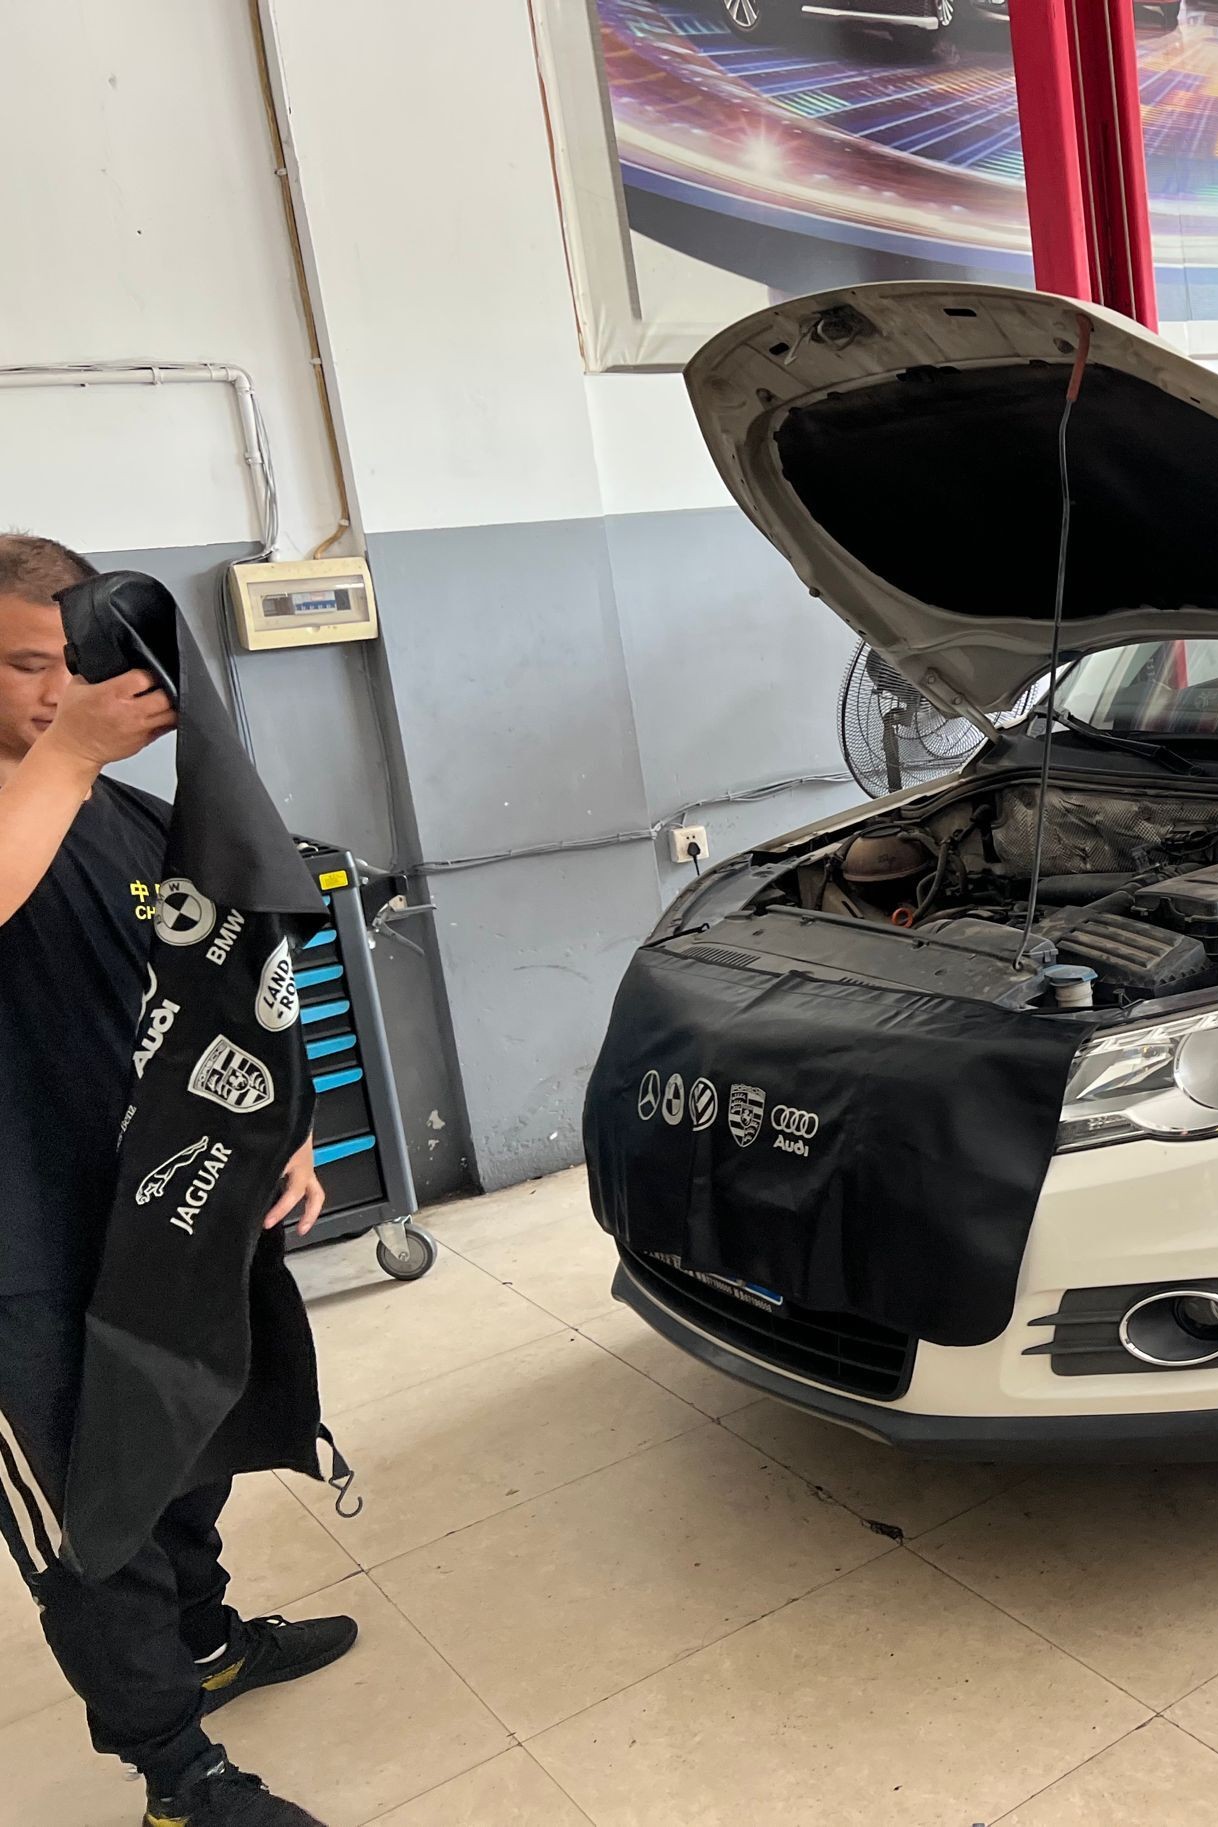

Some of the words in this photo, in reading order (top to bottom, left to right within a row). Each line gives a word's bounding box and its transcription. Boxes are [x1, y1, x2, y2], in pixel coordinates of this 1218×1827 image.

[206, 908, 245, 966] BMW
[264, 960, 289, 1009] LAND
[169, 1142, 232, 1235] JAGUAR
